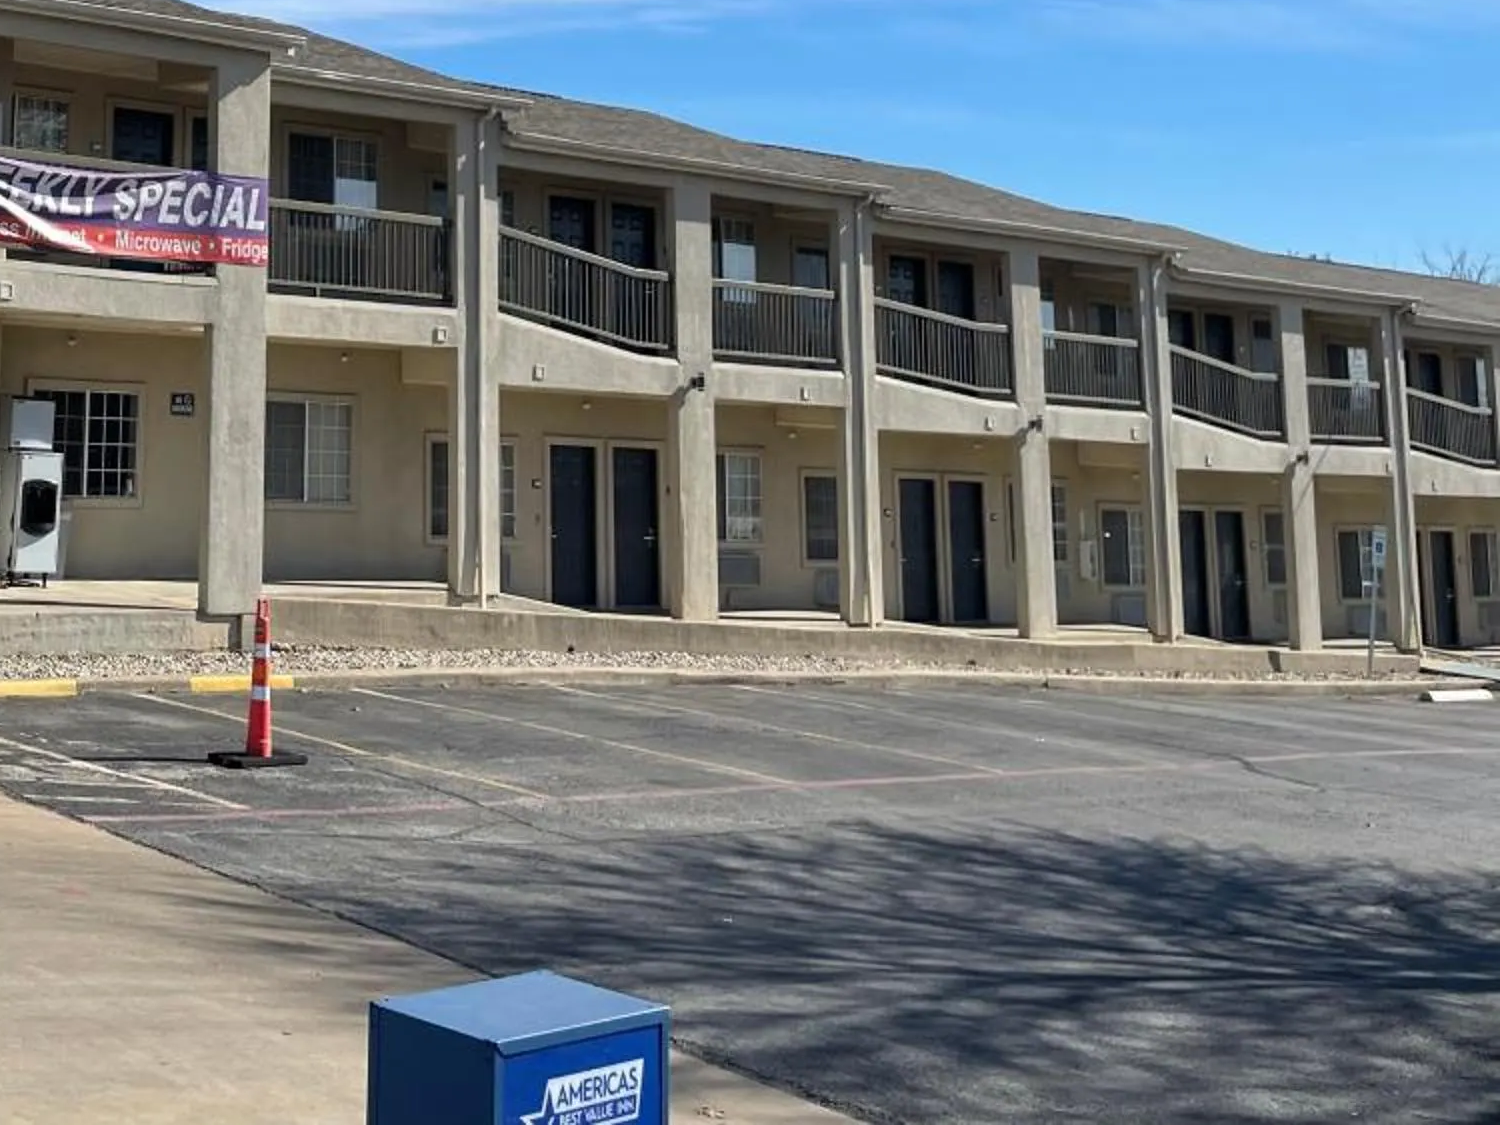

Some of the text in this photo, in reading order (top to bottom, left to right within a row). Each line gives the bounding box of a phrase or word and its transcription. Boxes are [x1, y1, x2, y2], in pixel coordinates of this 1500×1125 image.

[113, 178, 266, 231] SPECIAL
[115, 229, 202, 255] Microwave
[221, 238, 269, 264] Fridge
[557, 1067, 639, 1108] AMERICAS
[583, 1102, 615, 1122] VALUE
[616, 1097, 636, 1116] INN
